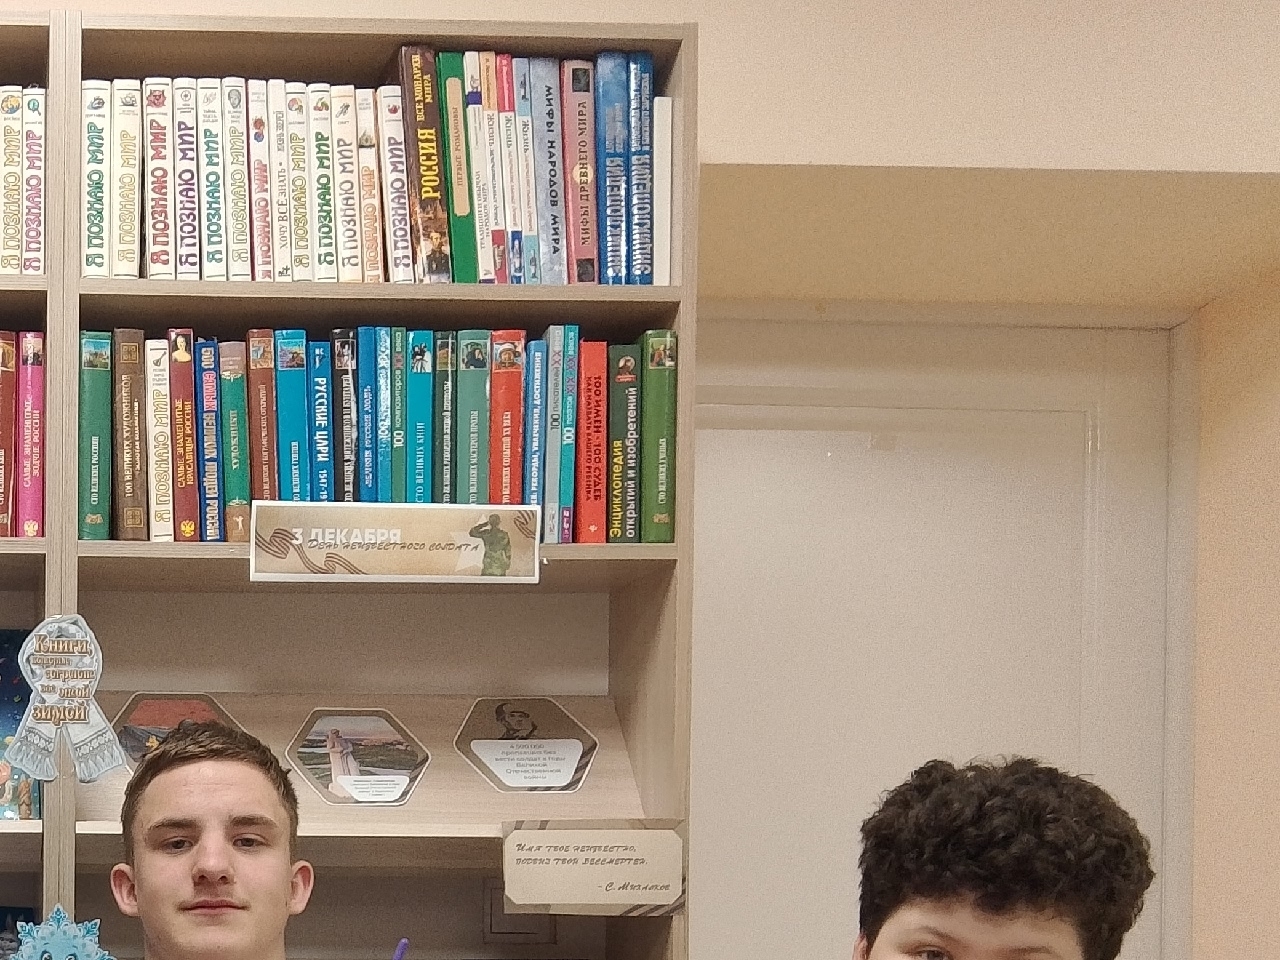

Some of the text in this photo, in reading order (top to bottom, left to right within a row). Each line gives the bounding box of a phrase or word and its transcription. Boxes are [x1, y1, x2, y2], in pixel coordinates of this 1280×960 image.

[412, 54, 425, 122] ВСЕ МОНАРХИ
[424, 74, 433, 103] МИРА
[86, 122, 103, 267] Я ПОЗНАЮ МИР
[150, 119, 169, 264] Я ПОЗНАЮ МИР
[178, 121, 197, 266] Я ПОЗНАЮ МИР
[204, 129, 222, 263] Я ПОЗНАЮ МИР
[277, 168, 287, 197] ЗНАТЬ
[315, 132, 334, 265] Я ПОЗНАЮ МИР
[418, 128, 441, 200] РОССИЯ
[545, 85, 560, 254] МИФЫ НАРОДОВ МИРА
[577, 101, 591, 245] МИФЫ ДРЕВНЕГО МИРА
[24, 130, 42, 271] Я ПОЗНАЮ МИР
[606, 157, 623, 277] ЭНЦИКЛОПЕДИЯ
[632, 155, 651, 275] ЭНЦИКЛОПЕДИЯ
[279, 225, 288, 249] ХОЧУ
[122, 375, 131, 438] ХУДОЖНИКОВ
[203, 371, 217, 411] САМЫХ
[314, 377, 329, 461] РУССКИЕ ЦАРИ
[124, 440, 132, 481] ВЕЛИКИХ
[153, 390, 170, 522] Я ПОЗНАЮ МИР
[184, 401, 193, 484] КРАСАВИЦЫ РОССИИ
[204, 413, 216, 458] ВЕЛИКИХ
[416, 446, 424, 483] ВЕЛИКИХ
[531, 453, 540, 490] РЕКОРДЫ,
[625, 388, 637, 538] открытий и изобретений
[203, 462, 218, 497] ЛЮДЕЙ
[416, 486, 424, 503] СТО
[610, 440, 624, 538] Энциклопедия
[291, 528, 401, 544] 3 ДЕКАБРЯ
[34, 634, 93, 655] Книги,
[32, 702, 87, 726] зимой
